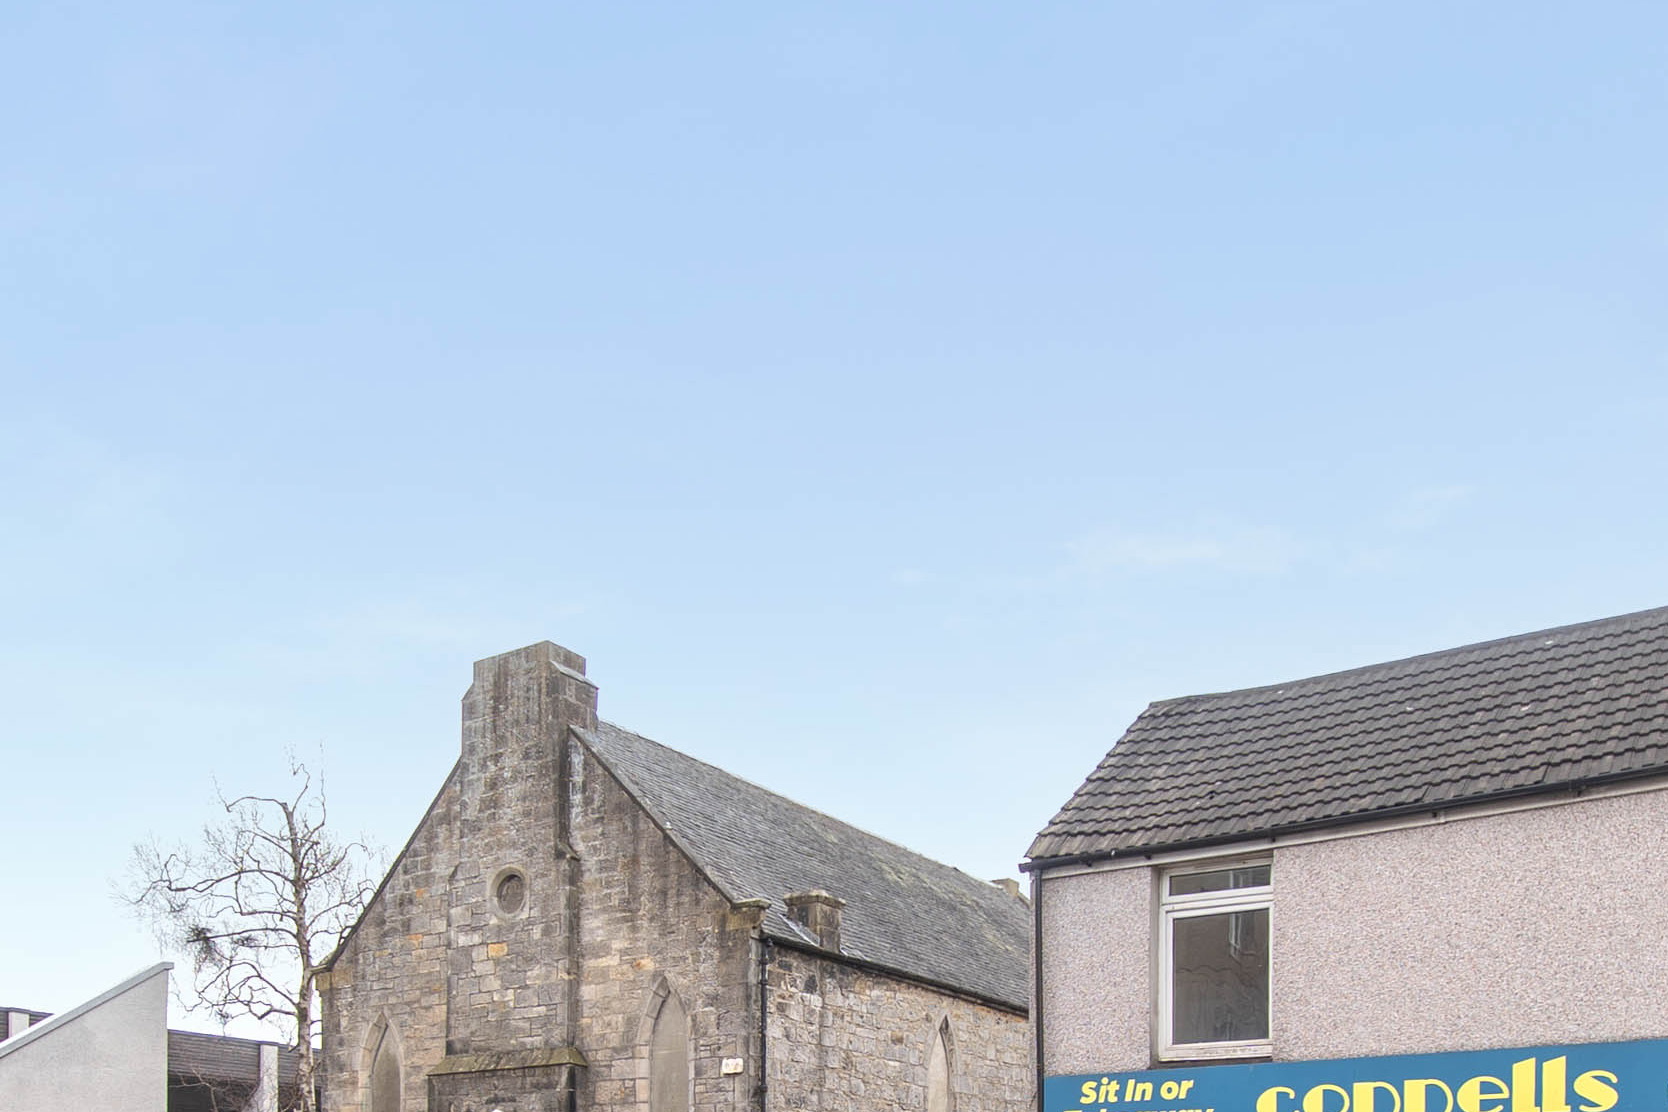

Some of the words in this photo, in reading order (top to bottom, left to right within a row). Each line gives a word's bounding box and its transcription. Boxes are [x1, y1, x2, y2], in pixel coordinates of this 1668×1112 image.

[1080, 1077, 1120, 1104] Sit
[1124, 1078, 1154, 1102] In
[1160, 1079, 1194, 1101] or
